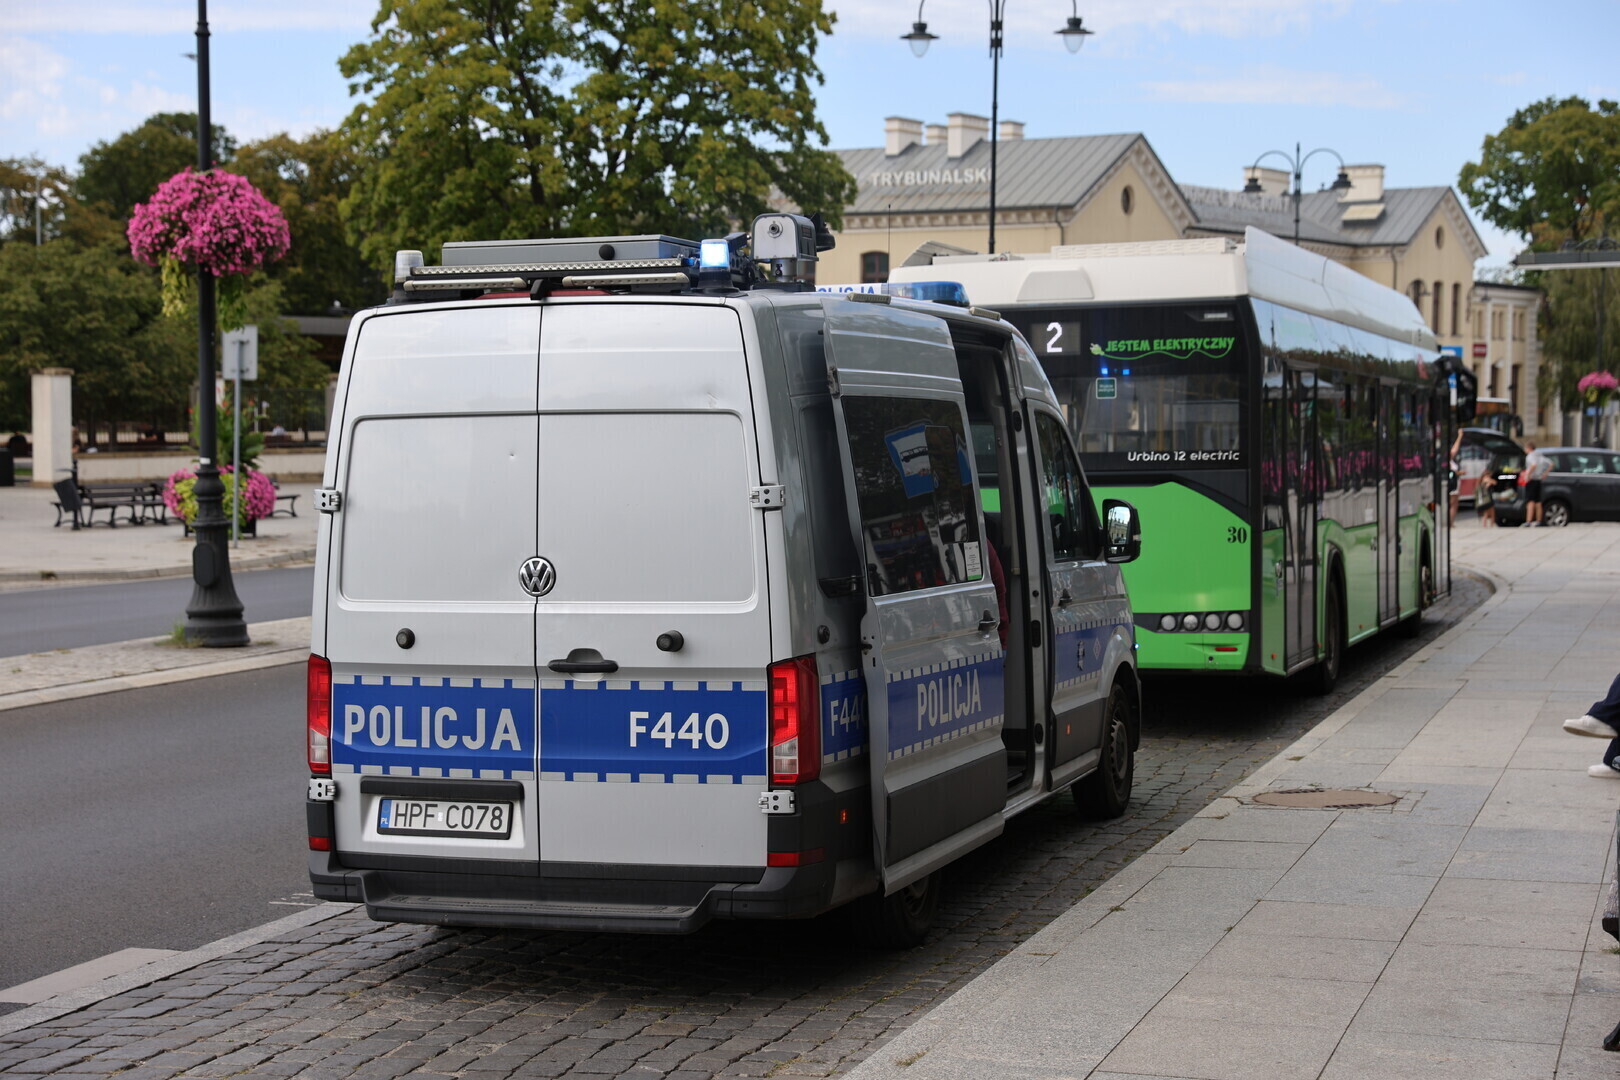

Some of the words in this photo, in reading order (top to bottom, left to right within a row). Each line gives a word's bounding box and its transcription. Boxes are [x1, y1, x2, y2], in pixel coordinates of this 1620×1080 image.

[1046, 322, 1063, 353] 2
[1105, 339, 1151, 352] JESTEM
[1153, 337, 1235, 351] ELEKTRYCZNY
[1127, 451, 1171, 462] Urbino
[1174, 451, 1186, 461] 12
[1190, 450, 1240, 461] electric
[1227, 526, 1247, 544] 30
[917, 668, 982, 732] POLICJA
[343, 703, 522, 752] POLICJA
[629, 710, 730, 750] F440
[380, 817, 389, 825] PL
[394, 802, 438, 828] HPF
[446, 804, 504, 831] C078
